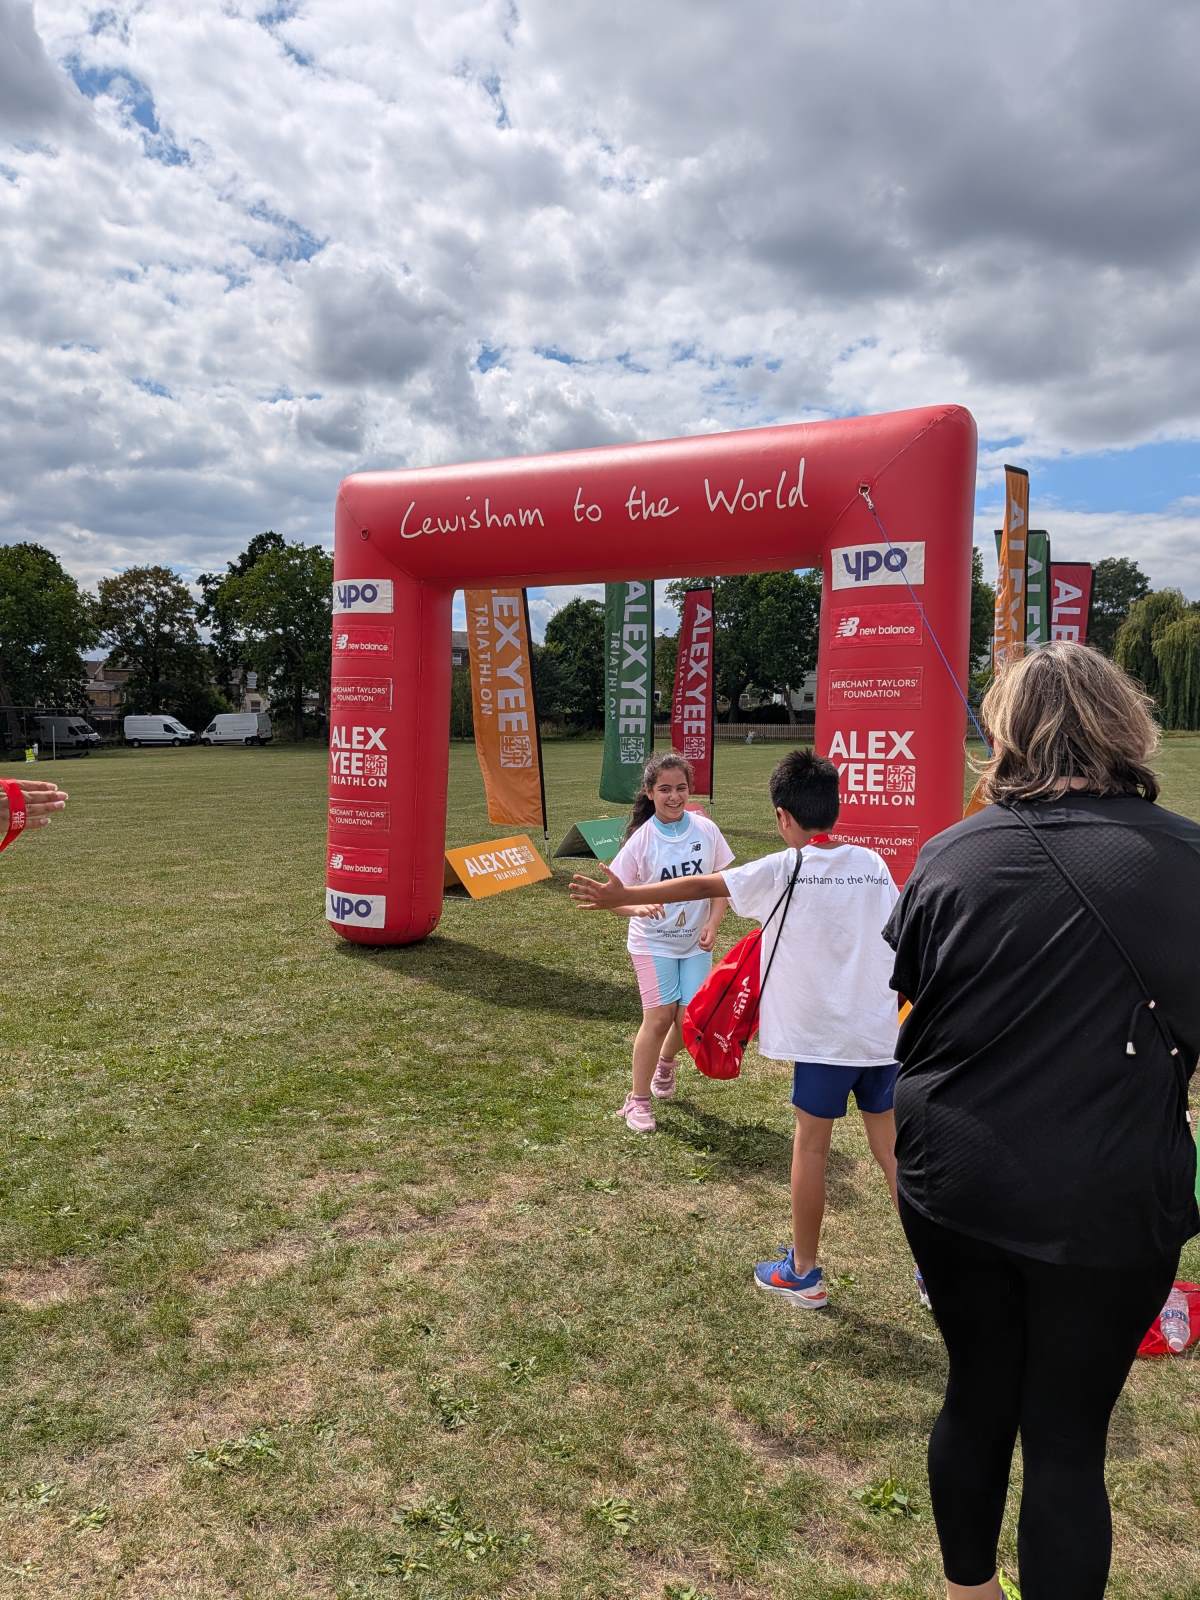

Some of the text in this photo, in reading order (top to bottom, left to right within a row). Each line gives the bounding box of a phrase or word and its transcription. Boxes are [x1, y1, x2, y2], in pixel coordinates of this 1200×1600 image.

[400, 457, 809, 539] Lewisham to the World
[842, 548, 908, 582] ypo
[337, 584, 378, 609] ypo
[1051, 579, 1082, 645] ALE
[860, 627, 876, 636] new
[878, 625, 916, 635] balance
[361, 642, 389, 652] balance
[475, 604, 493, 716] TRIATHLON
[357, 686, 388, 695] TAYLORS'
[496, 655, 529, 732] YEE
[832, 679, 918, 689] MERCHANT TAYLORS'
[843, 689, 900, 699] FOUNDATION
[336, 694, 374, 702] FOUNDATION
[331, 725, 388, 751] ALEX
[828, 731, 916, 760] ALEX
[330, 751, 364, 776] YEE
[331, 775, 387, 788] TRIATHLON
[335, 816, 373, 826] FOUNDATION
[873, 836, 915, 846] TAYLORS'
[343, 864, 354, 872] new
[355, 864, 383, 874] balance
[464, 852, 504, 878] ALEX
[495, 848, 526, 868] YEE
[660, 858, 704, 882] ALEX
[836, 877, 845, 885] to
[847, 875, 864, 885] the
[331, 893, 372, 921] ypo
